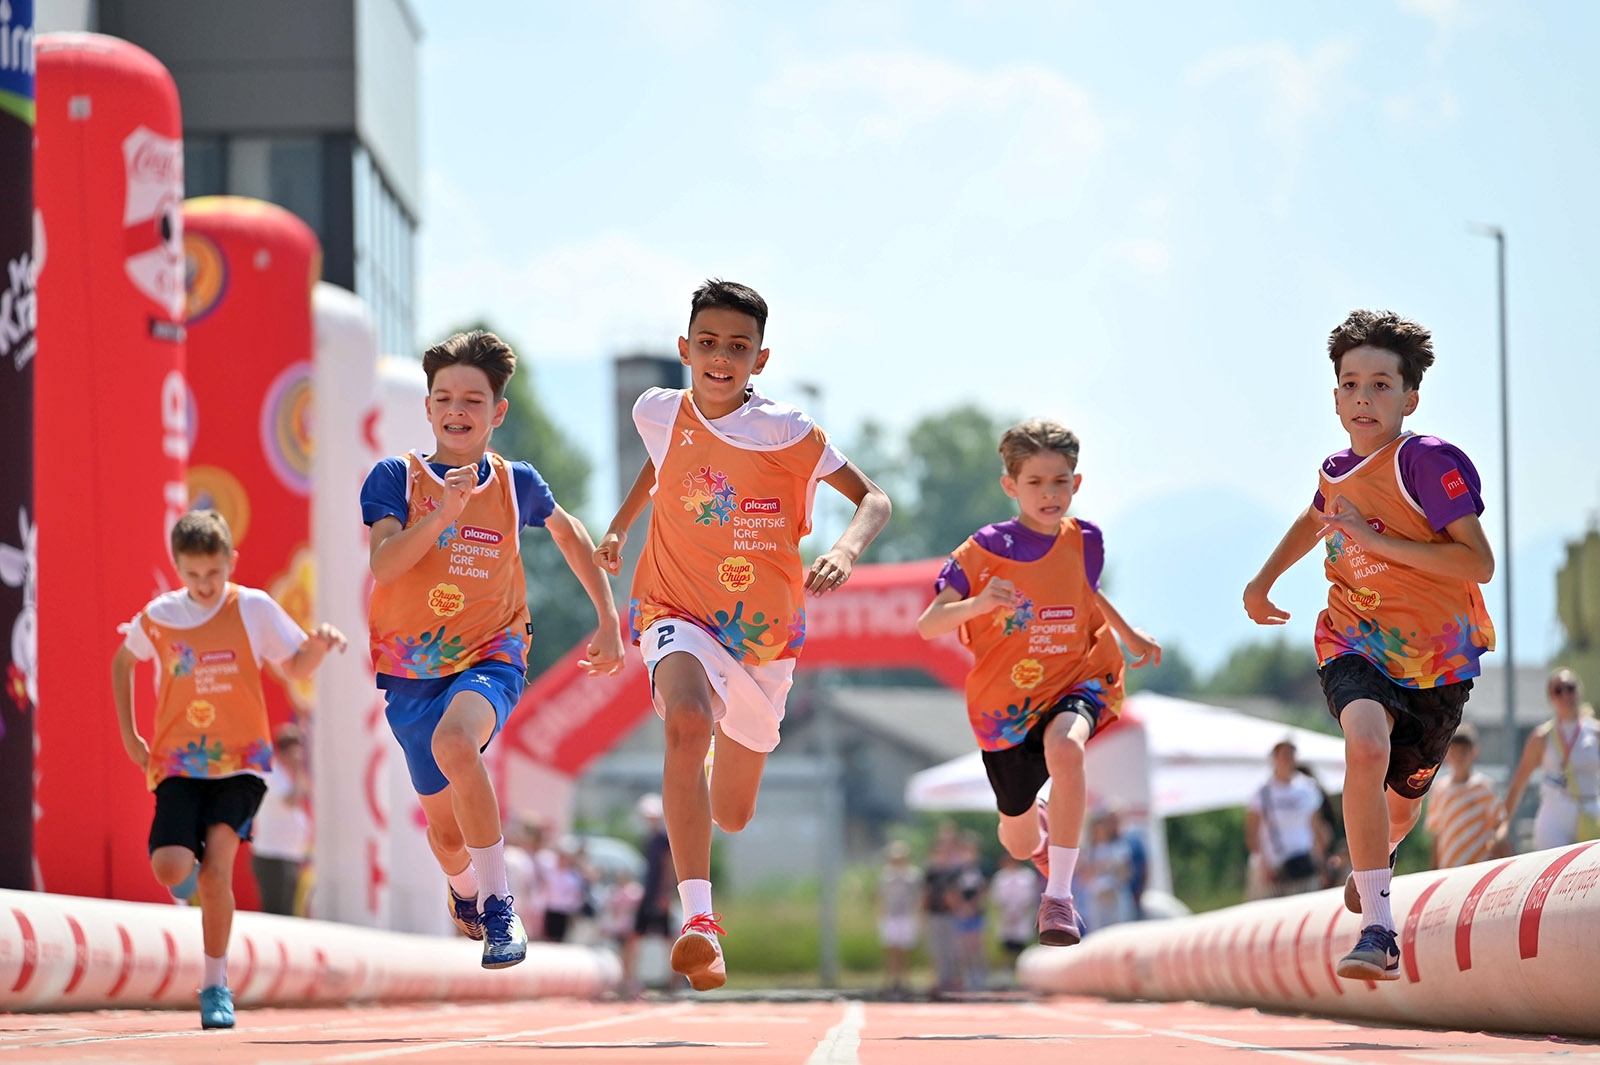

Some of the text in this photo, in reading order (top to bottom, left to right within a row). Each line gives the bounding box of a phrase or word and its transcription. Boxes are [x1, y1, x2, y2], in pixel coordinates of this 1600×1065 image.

[744, 500, 777, 511] plazma
[733, 516, 786, 528] SPORTSKE
[464, 528, 499, 542] plazma
[733, 528, 759, 539] IGRE
[451, 542, 501, 559] SPORTSKE
[733, 540, 777, 551] MLADIH
[450, 554, 475, 566] IGRE
[1349, 555, 1368, 568] IGRE
[448, 565, 489, 579] MLADIH
[721, 563, 751, 574] Chupa
[1353, 562, 1390, 580] MLADIH
[720, 572, 751, 588] Chups
[432, 589, 462, 602] Chupa
[429, 598, 460, 613] Chups
[1030, 624, 1077, 634] SPORTSKE
[657, 624, 676, 650] 2
[1028, 634, 1053, 644] IGRE
[1028, 644, 1068, 654] MLADIH
